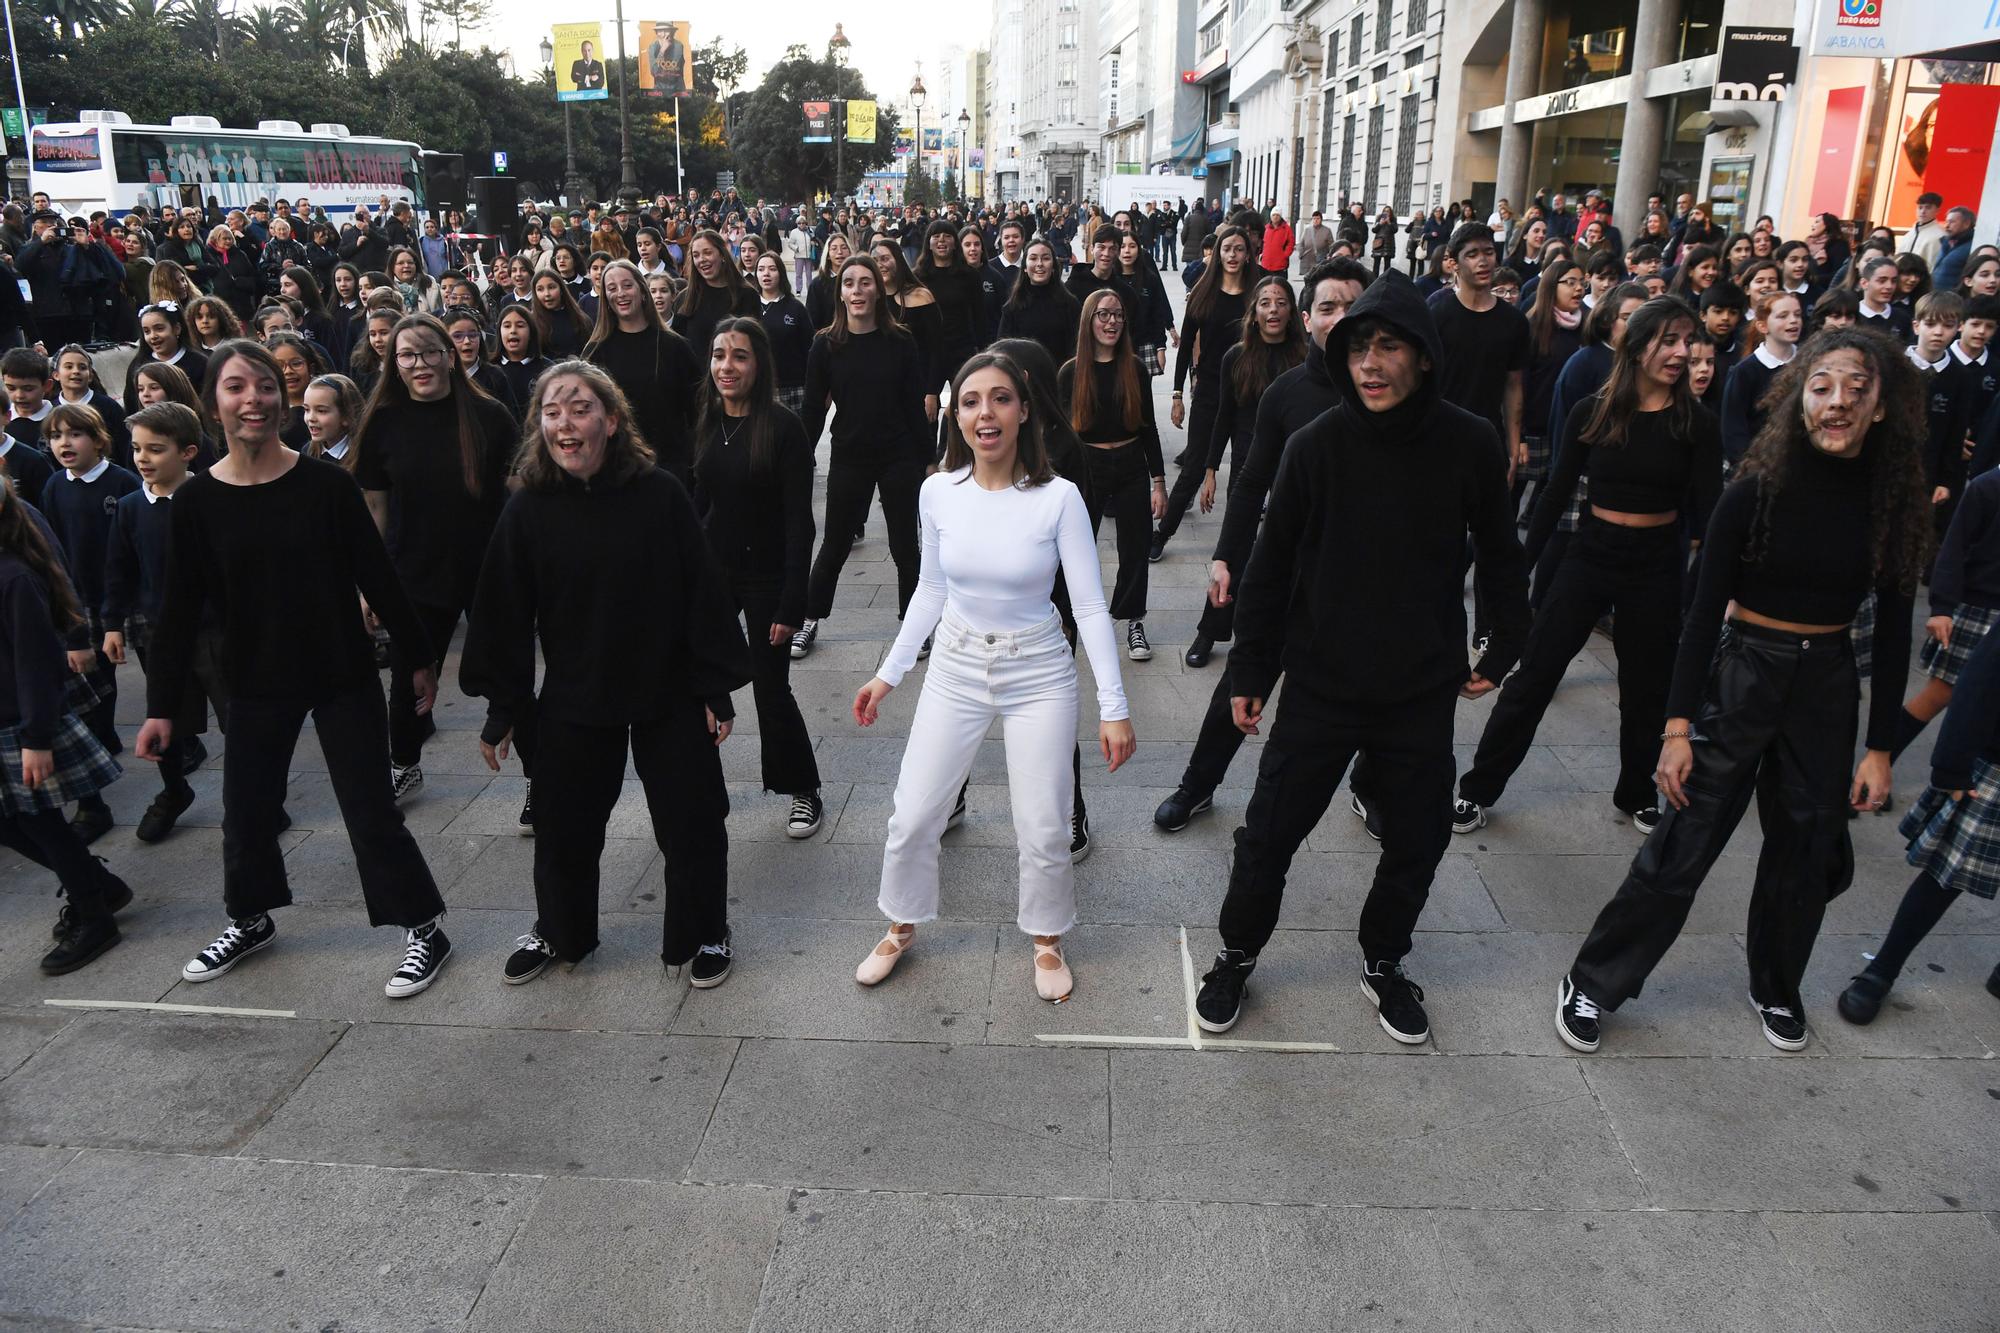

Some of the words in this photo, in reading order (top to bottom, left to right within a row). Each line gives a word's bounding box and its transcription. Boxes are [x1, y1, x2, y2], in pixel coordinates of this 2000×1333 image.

[1839, 16, 1858, 24] EURO
[1859, 17, 1880, 25] 6000
[303, 149, 343, 191] DOA
[342, 149, 409, 191] SANGUE
